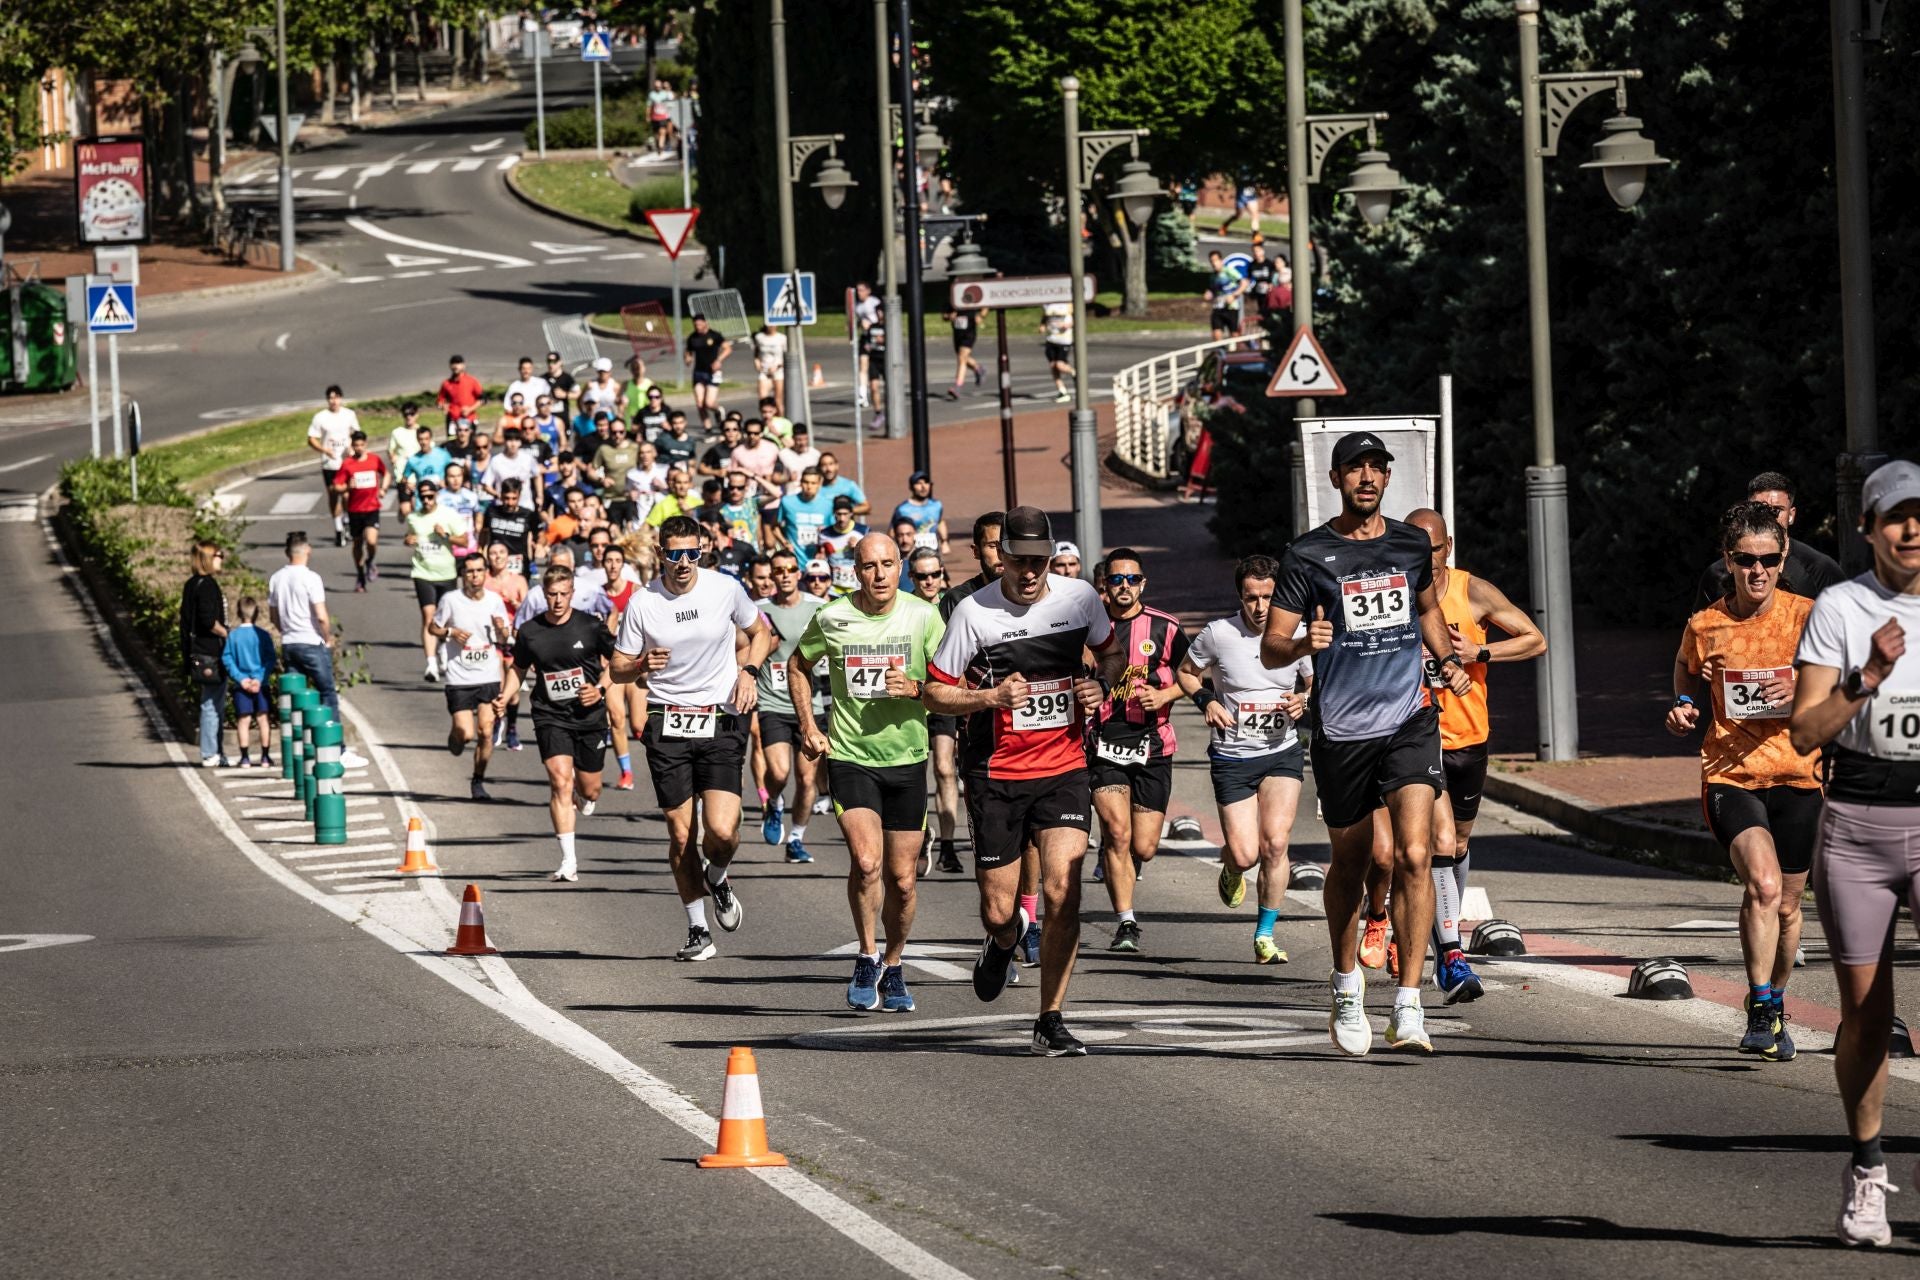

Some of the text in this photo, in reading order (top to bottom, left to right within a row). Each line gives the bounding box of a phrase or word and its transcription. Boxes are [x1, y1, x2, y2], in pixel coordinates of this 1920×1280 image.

[82, 162, 138, 177] McFlurry
[1352, 590, 1404, 617] 313
[675, 609, 699, 622] BAUM
[1369, 613, 1392, 621] JORGE
[465, 650, 489, 661] 406
[551, 677, 581, 692] 486
[852, 668, 883, 686] 47
[1732, 684, 1767, 705] 34
[1020, 693, 1069, 717] 399
[670, 713, 709, 729] 377
[1244, 713, 1284, 729] 426
